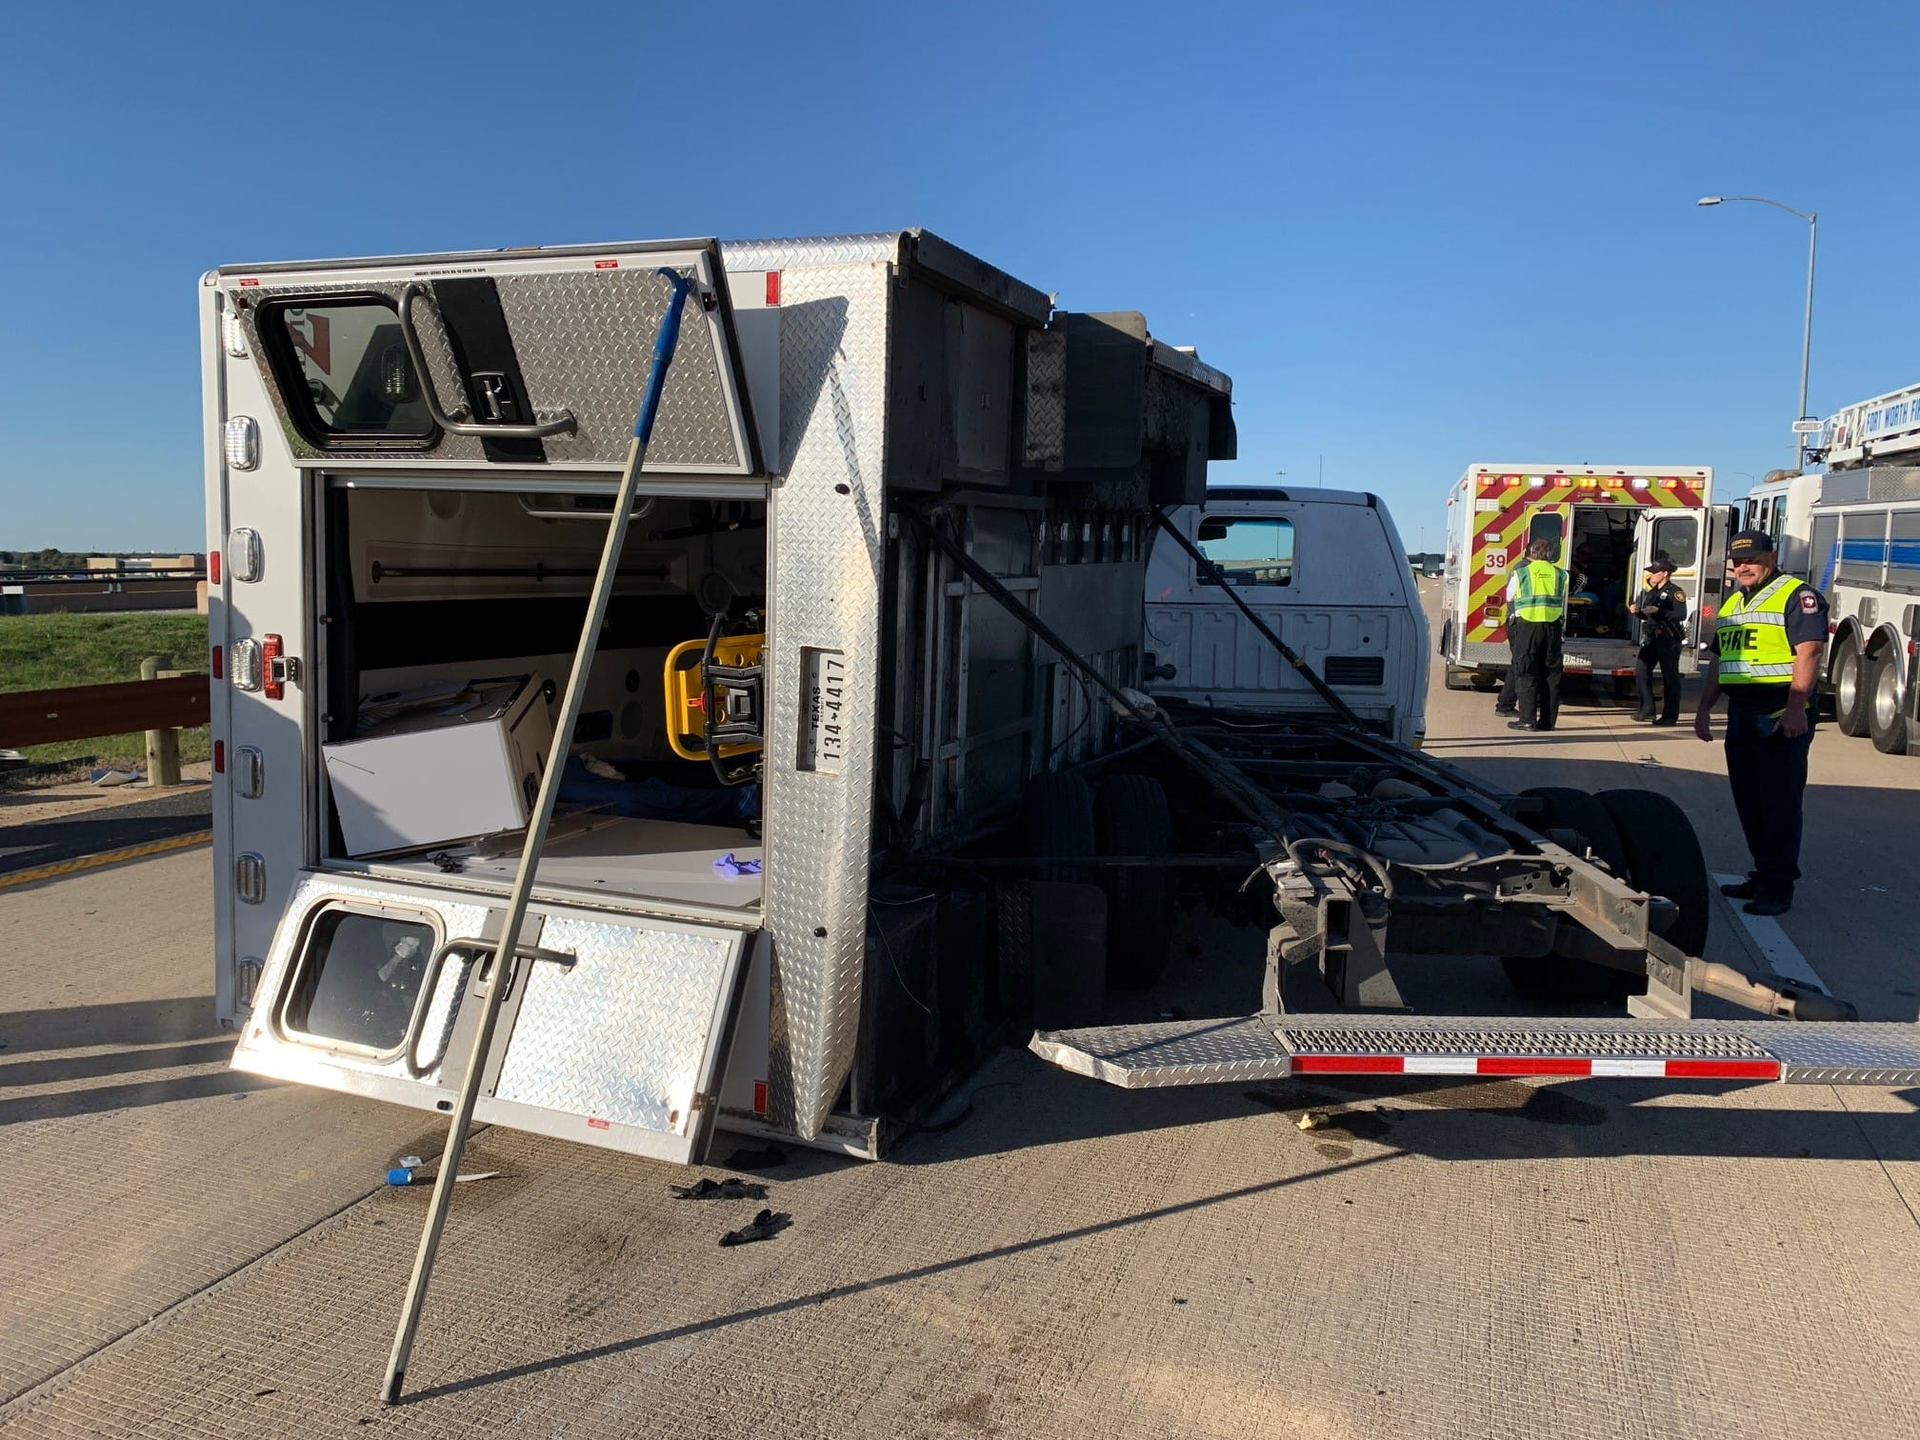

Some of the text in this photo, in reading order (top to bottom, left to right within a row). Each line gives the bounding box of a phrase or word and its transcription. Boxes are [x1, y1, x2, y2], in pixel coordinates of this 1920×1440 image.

[1866, 410, 1882, 433] FORT
[1885, 402, 1909, 428] WORTH
[1486, 554, 1506, 568] 39
[1720, 629, 1758, 651] FIRE
[811, 687, 821, 730] TEXAS
